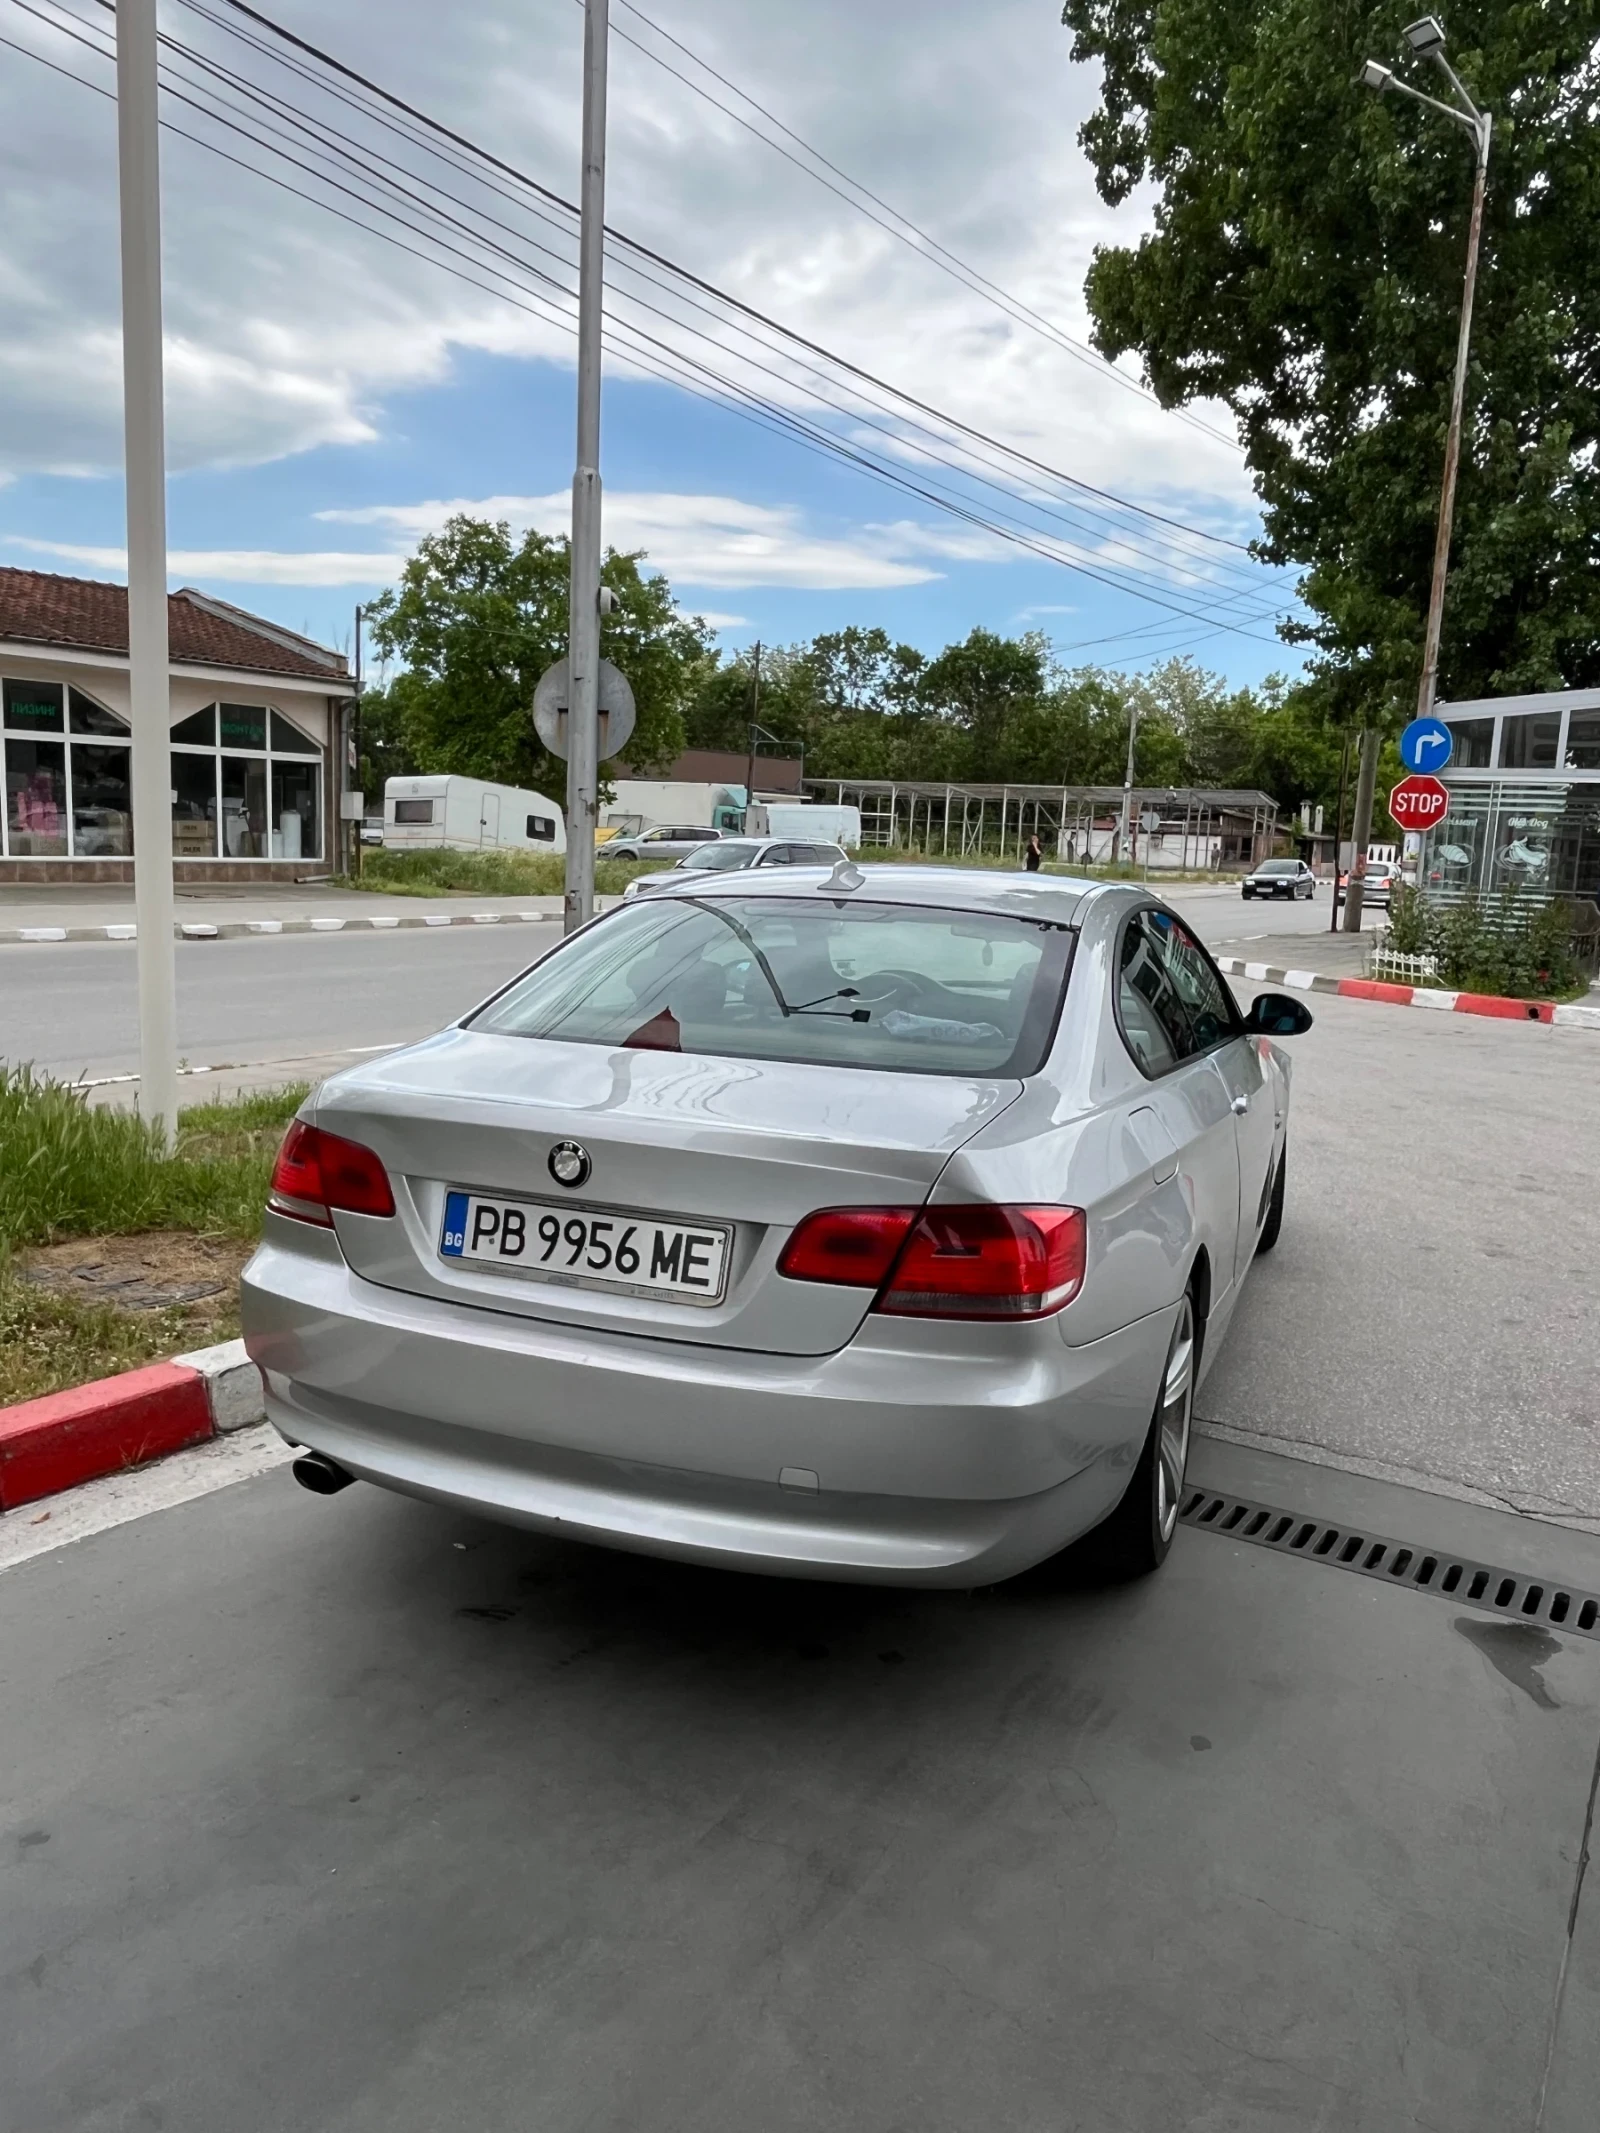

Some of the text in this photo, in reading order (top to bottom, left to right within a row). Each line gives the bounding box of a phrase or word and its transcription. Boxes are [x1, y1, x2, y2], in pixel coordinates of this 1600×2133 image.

[1395, 792, 1443, 814] STOP
[444, 1231, 463, 1247] BG
[471, 1204, 715, 1287] PB 9956 ME
